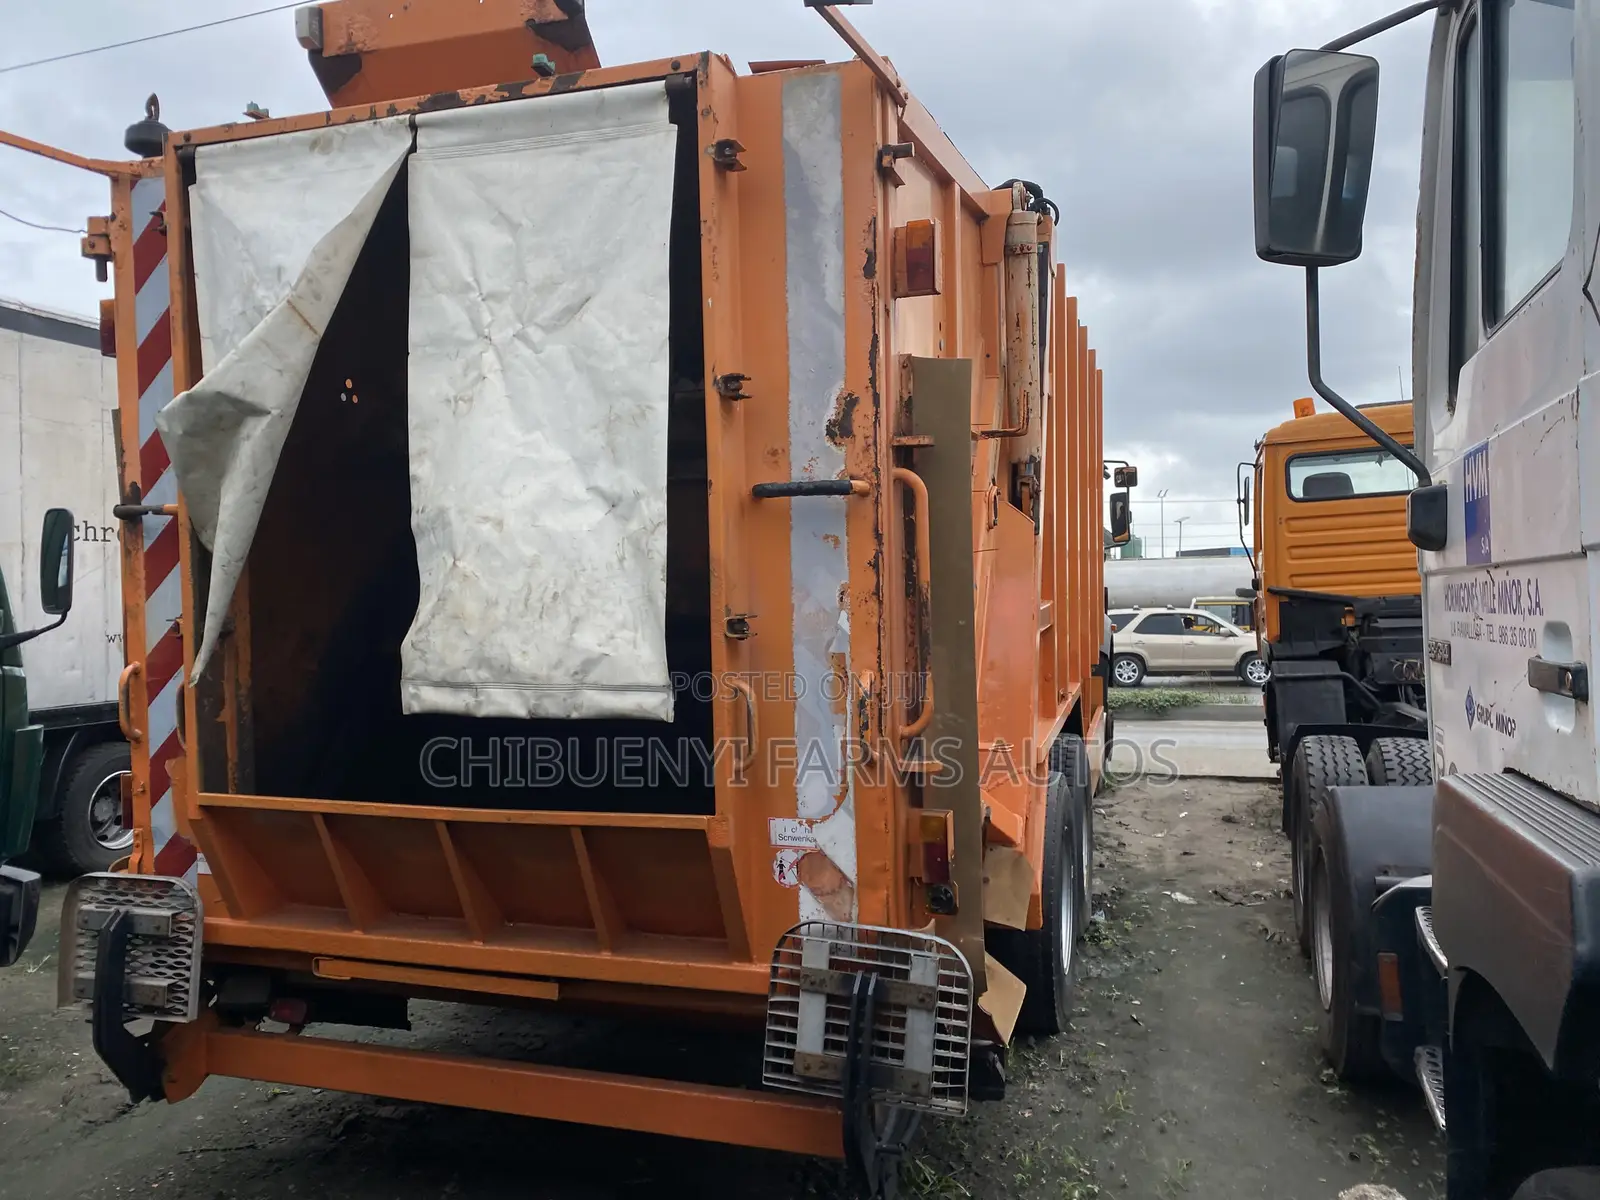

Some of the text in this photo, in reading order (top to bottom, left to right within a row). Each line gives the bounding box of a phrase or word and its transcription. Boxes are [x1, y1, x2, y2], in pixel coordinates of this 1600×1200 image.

[1465, 449, 1489, 503] HVM
[1498, 579, 1526, 622] MINOR,
[1527, 578, 1544, 616] S.A.
[1510, 626, 1518, 647] 35
[1519, 627, 1527, 648] 03
[1528, 628, 1537, 649] 00
